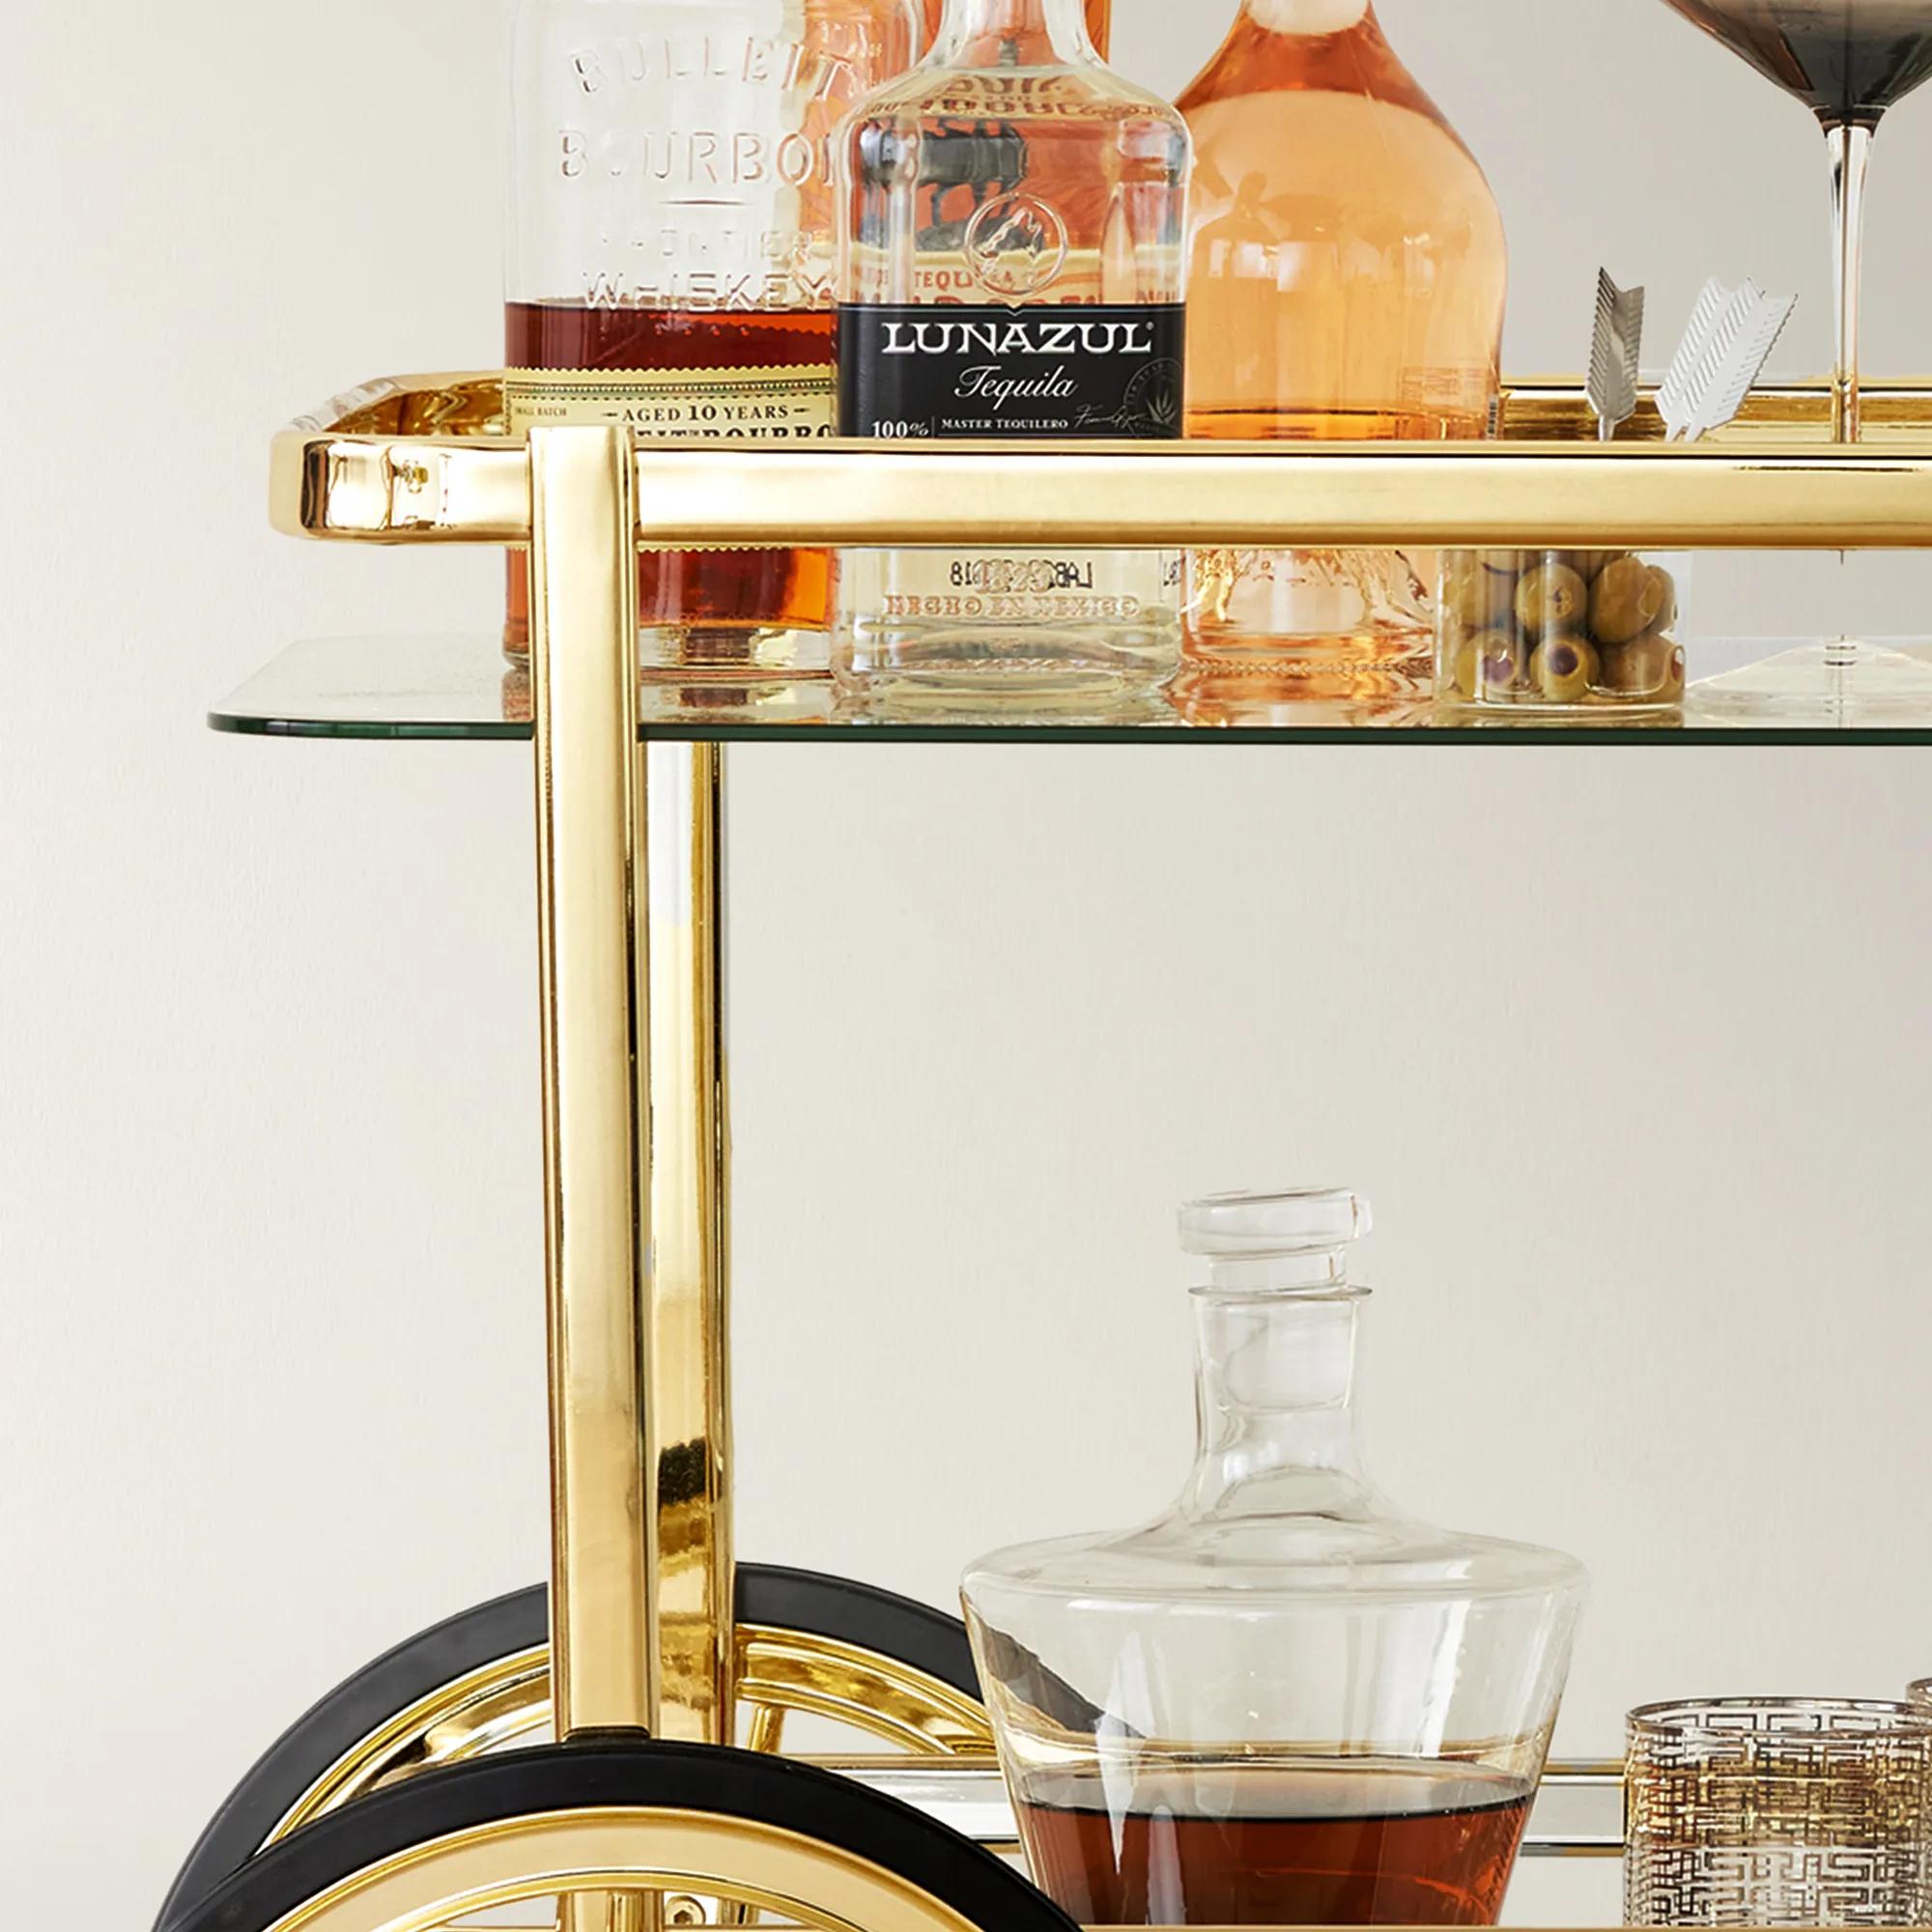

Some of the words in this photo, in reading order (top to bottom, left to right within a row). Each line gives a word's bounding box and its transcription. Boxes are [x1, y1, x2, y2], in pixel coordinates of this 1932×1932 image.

[582, 271, 838, 311] WHISKEY
[953, 364, 1079, 412] Tequila
[622, 408, 681, 422] AGED
[688, 405, 718, 421] 10
[724, 405, 789, 420] YEARS
[871, 420, 930, 439] 100%
[941, 418, 992, 430] MASTER
[996, 418, 1069, 430] TEQUILERO
[882, 594, 983, 616] HECHO
